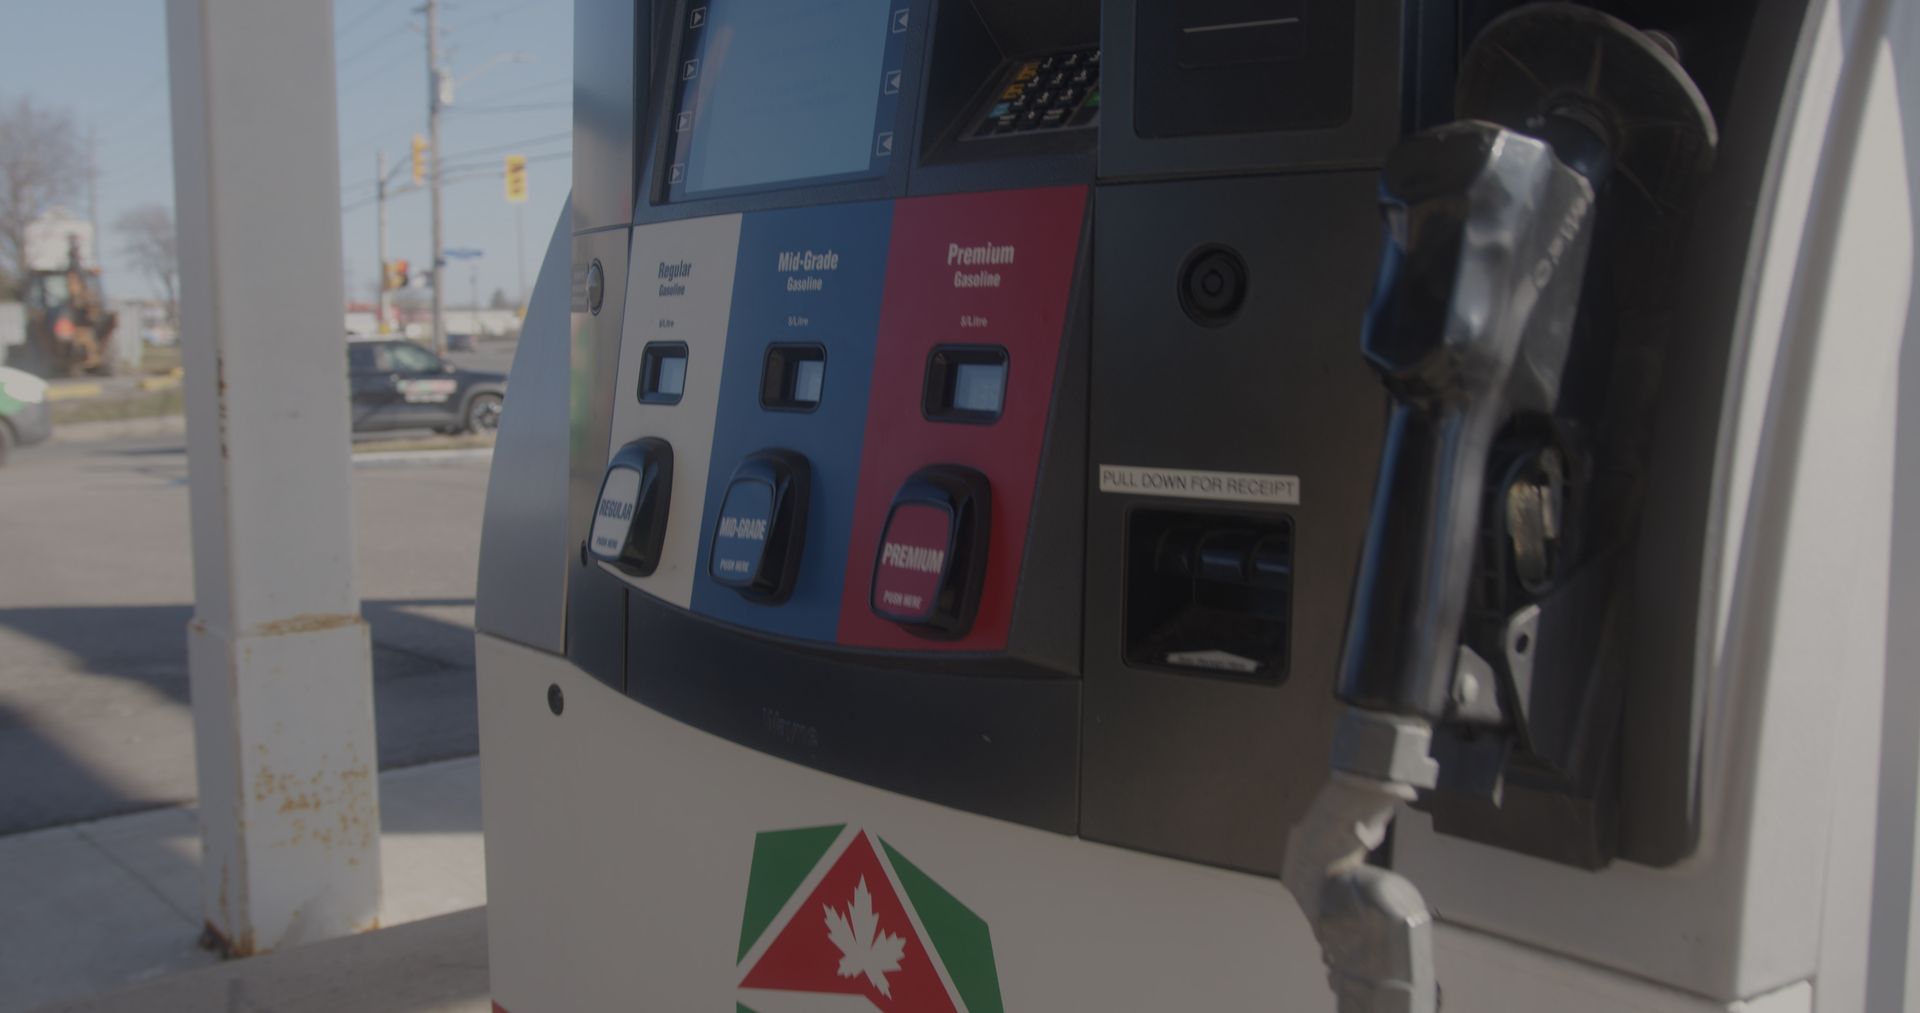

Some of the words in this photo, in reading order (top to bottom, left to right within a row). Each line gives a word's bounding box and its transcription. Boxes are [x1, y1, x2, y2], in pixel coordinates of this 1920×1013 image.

[778, 249, 839, 272] Mid-Grade
[947, 241, 1015, 266] Premium
[658, 260, 692, 281] Regular
[954, 271, 1001, 288] Gasoline
[659, 284, 686, 297] Gasoline
[787, 276, 823, 292] Gasoline
[1103, 470, 1137, 489] PULL
[1142, 472, 1187, 490] DOWN
[1191, 475, 1223, 492] FOR
[1227, 478, 1296, 497] RECEIPT
[599, 499, 633, 520] REGULAR
[720, 517, 767, 540] MID-GRADE
[882, 542, 944, 574] PREMIUM
